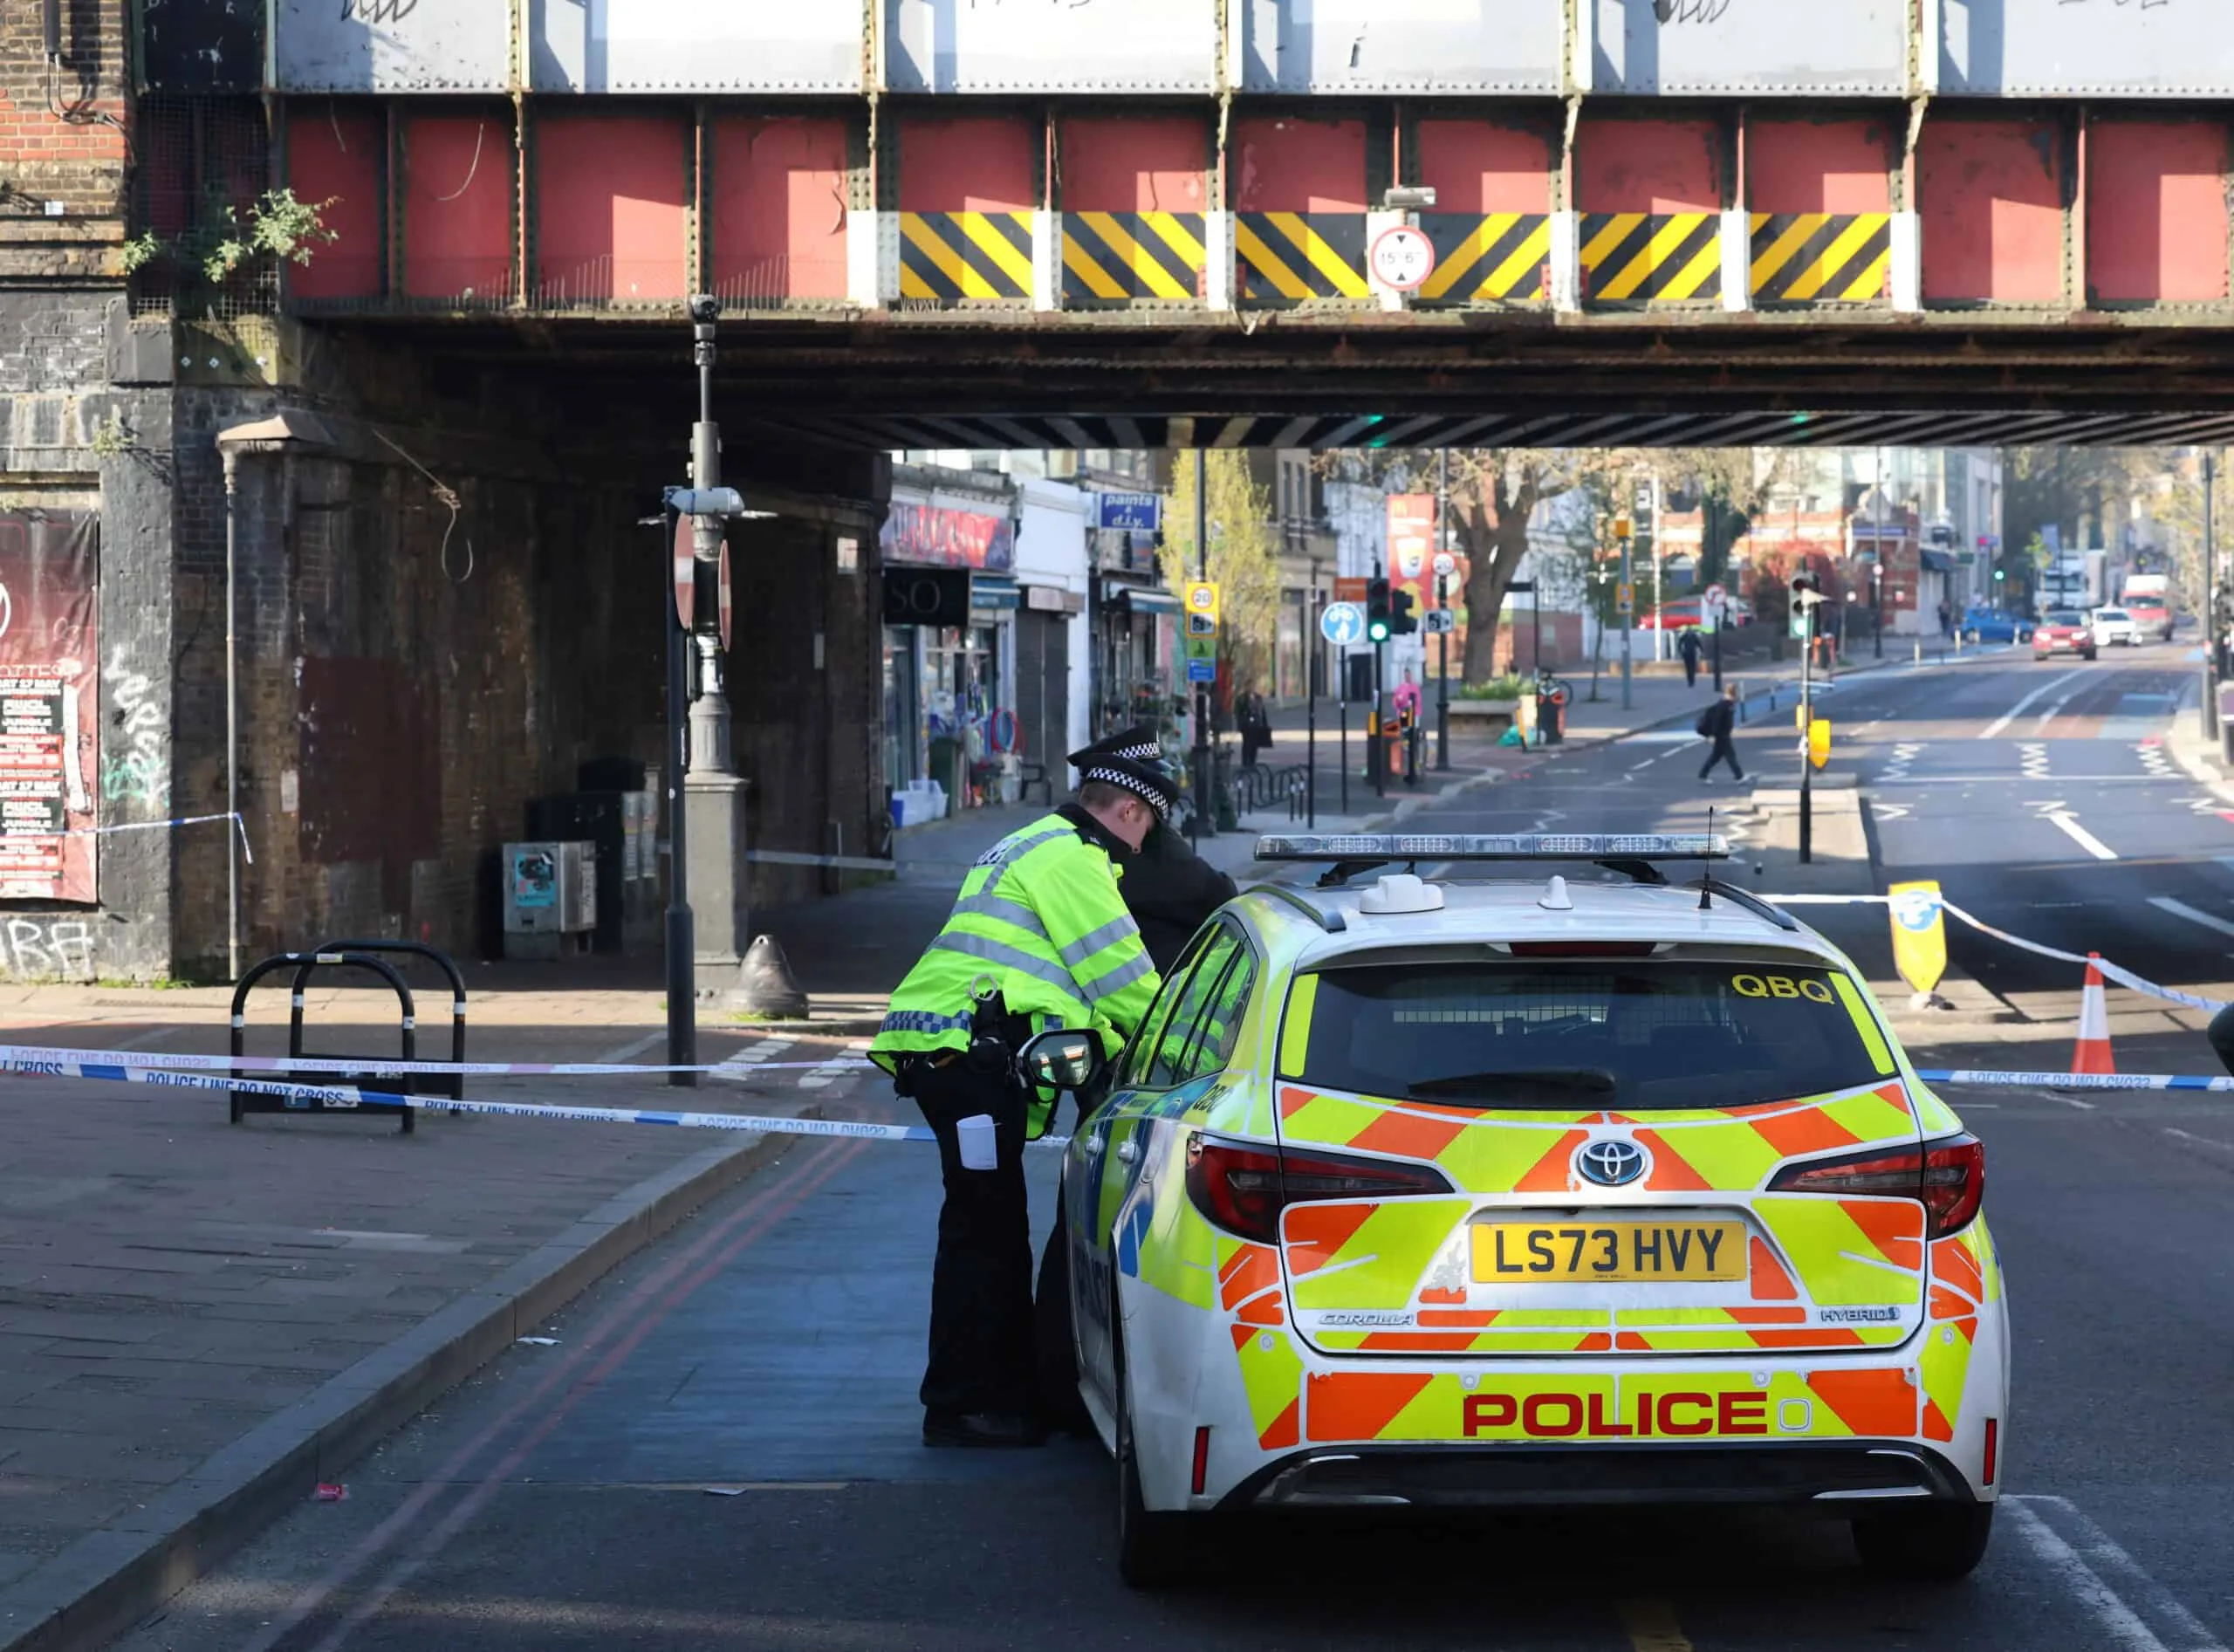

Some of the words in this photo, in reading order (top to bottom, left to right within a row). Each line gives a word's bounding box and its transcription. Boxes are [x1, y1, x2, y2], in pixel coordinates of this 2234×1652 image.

[1105, 496, 1154, 510] paints
[1731, 974, 1836, 1004] QBQ
[147, 1073, 198, 1087] POLICE
[202, 1077, 233, 1091] LINE
[238, 1082, 258, 1094] DO
[1496, 1229, 1619, 1272] LS73
[1634, 1228, 1724, 1272] HVY
[1319, 1313, 1414, 1326] COROLLA
[1821, 1308, 1888, 1322] HYBRID
[1463, 1392, 1768, 1436] POLICE
